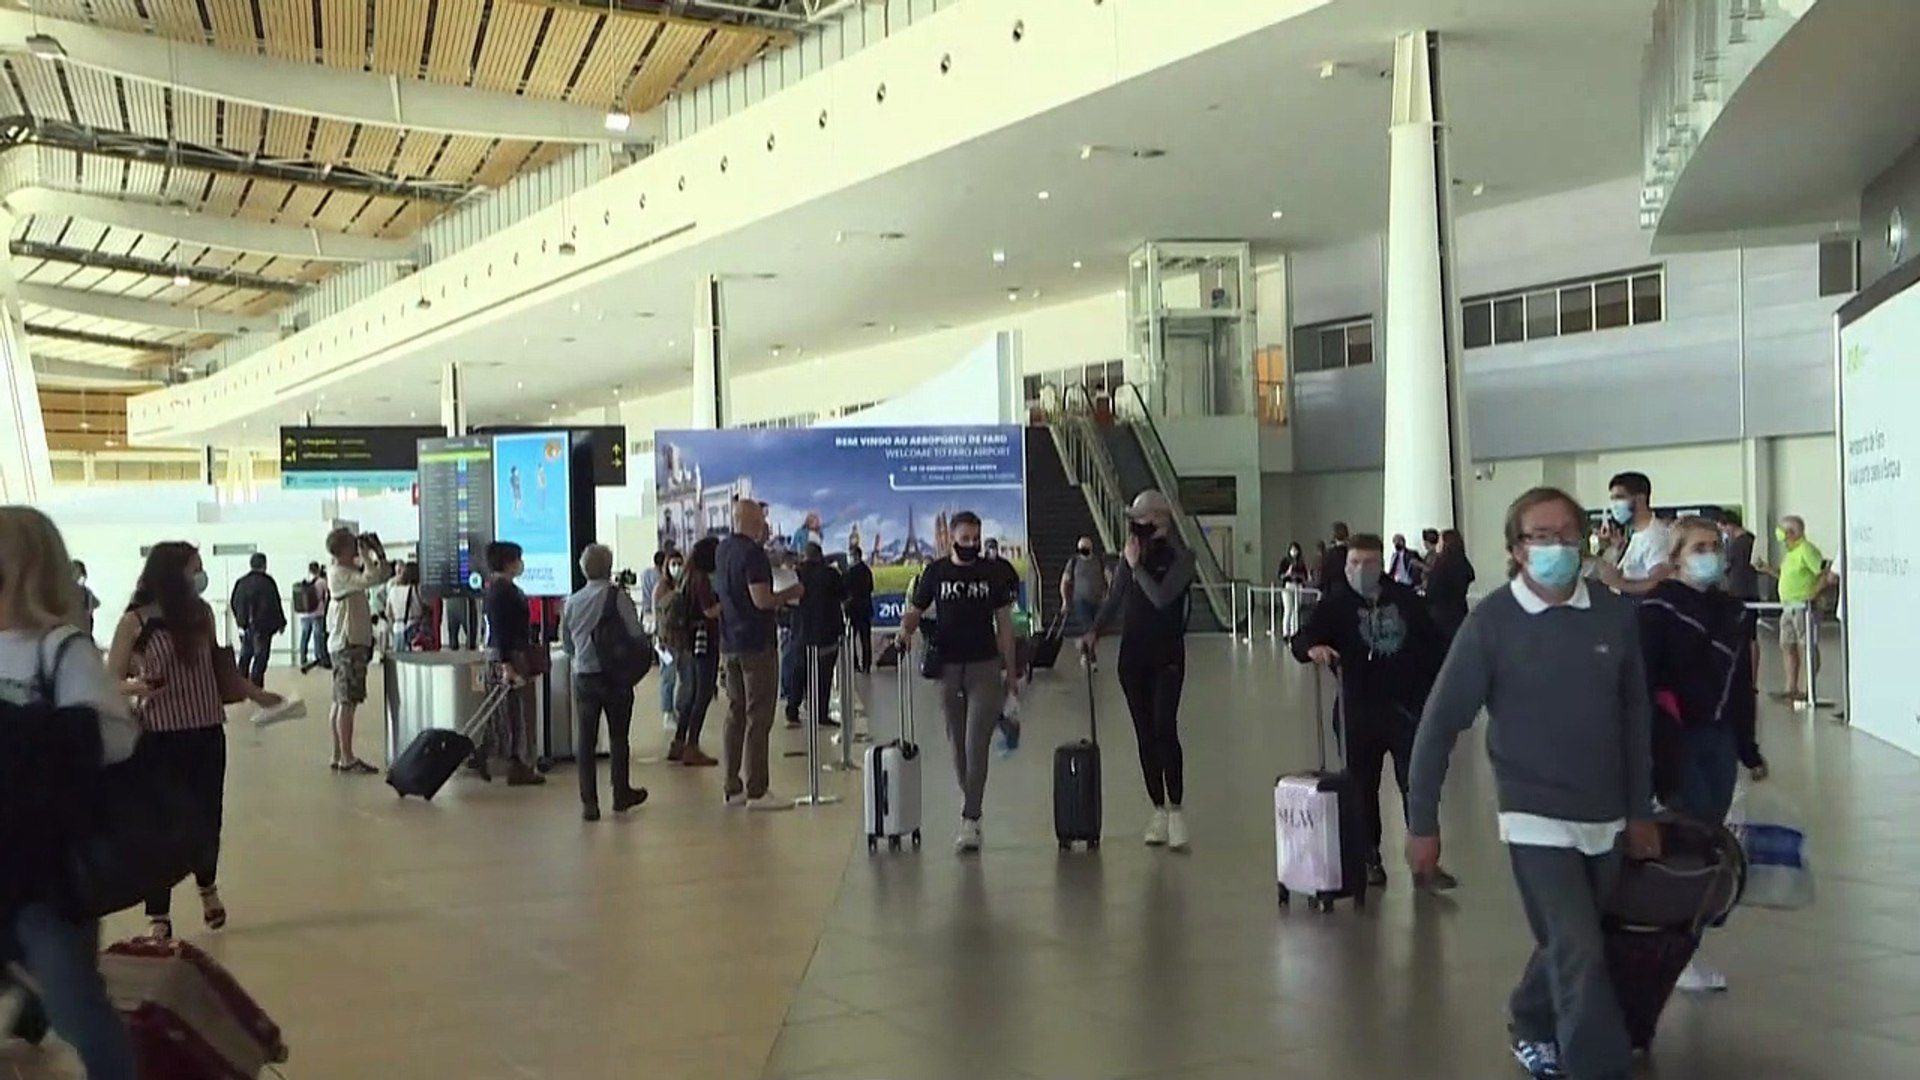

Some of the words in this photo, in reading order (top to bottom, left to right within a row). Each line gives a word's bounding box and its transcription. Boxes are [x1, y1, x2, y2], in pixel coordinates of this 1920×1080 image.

[835, 436, 858, 447] BEM
[860, 436, 892, 447] VINDO
[894, 435, 908, 446] AO
[909, 434, 966, 446] AEROPORTO
[968, 434, 980, 445] DE
[982, 433, 1008, 445] FARO
[885, 448, 931, 460] WELCOME
[934, 447, 947, 457] TO
[948, 447, 972, 457] FARO
[974, 446, 1010, 456] AIRPORT
